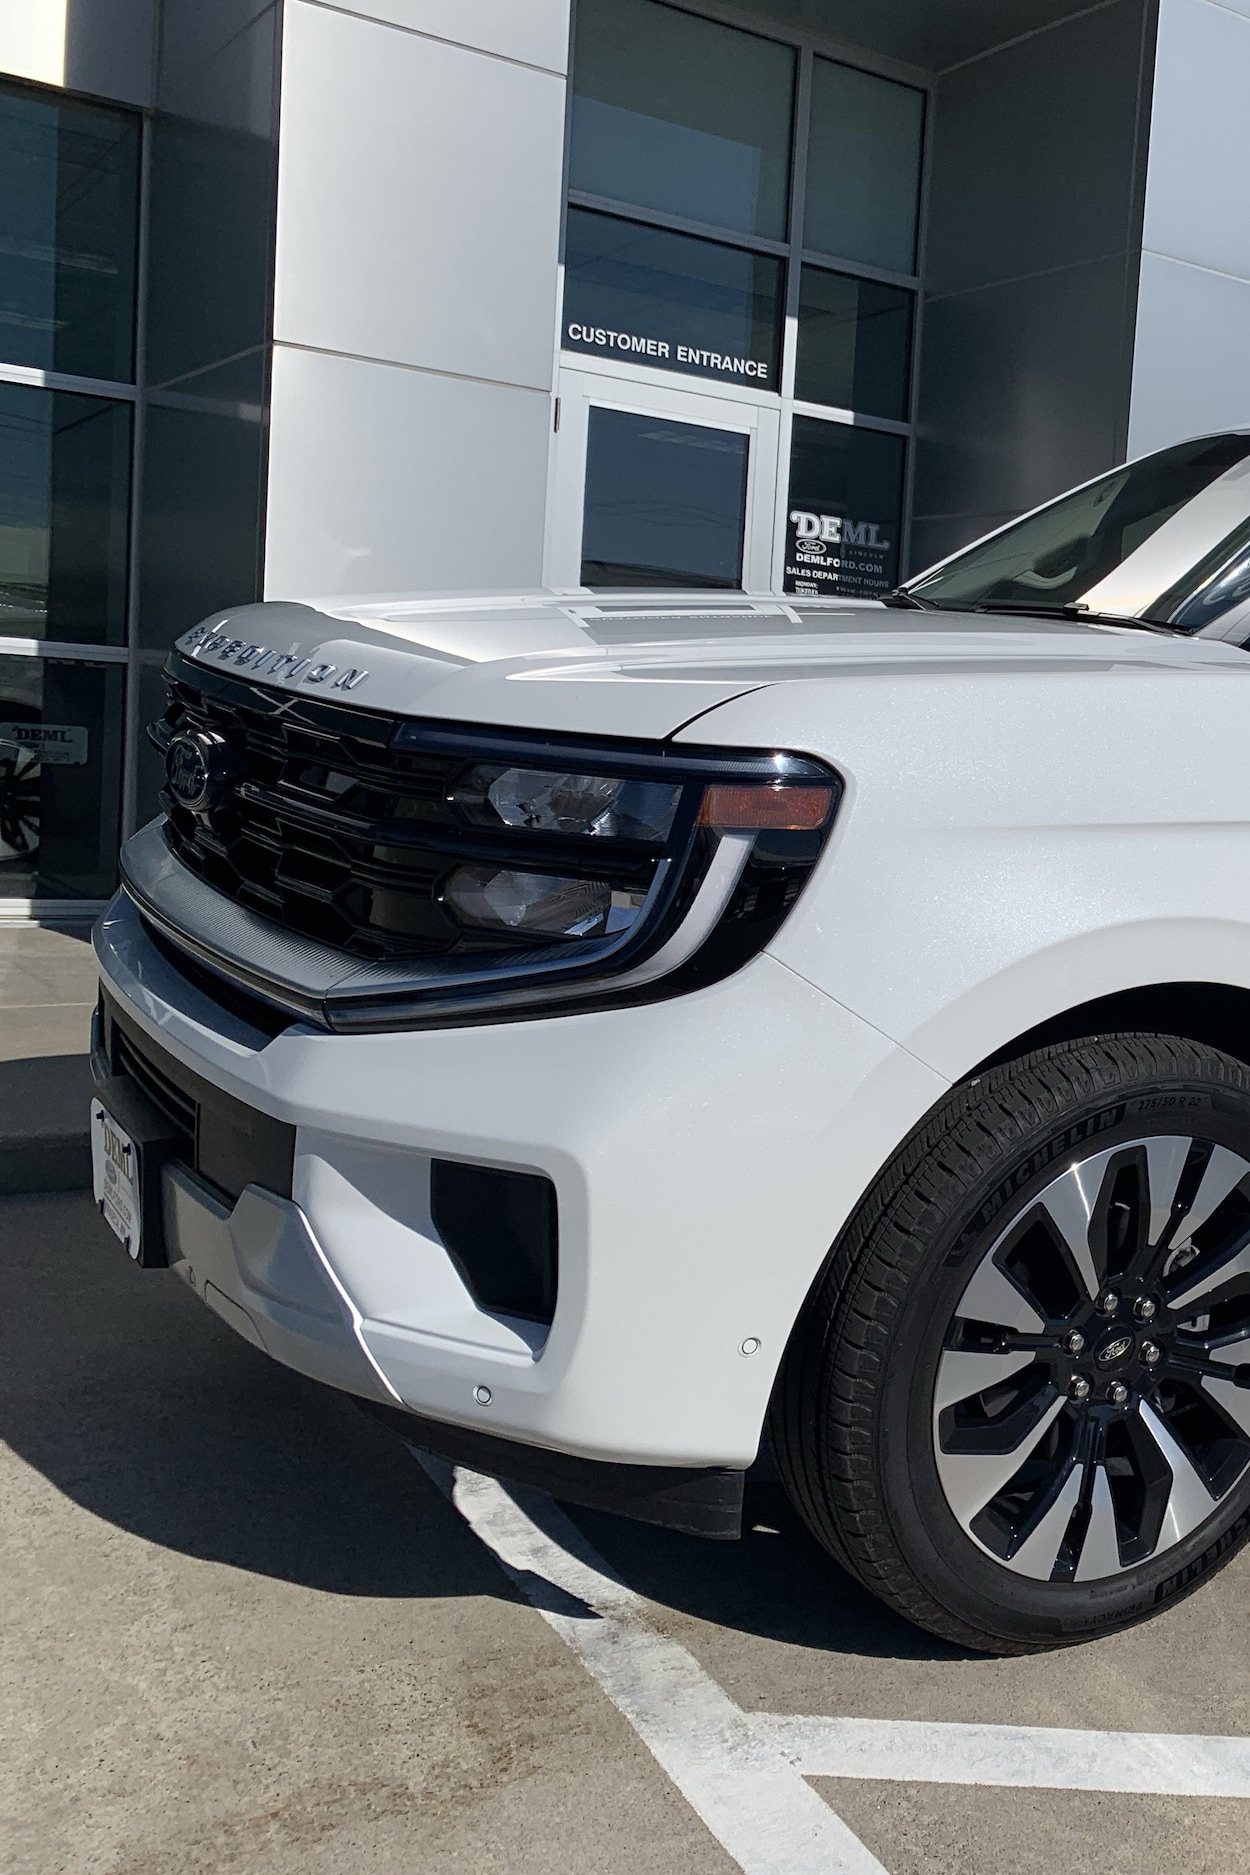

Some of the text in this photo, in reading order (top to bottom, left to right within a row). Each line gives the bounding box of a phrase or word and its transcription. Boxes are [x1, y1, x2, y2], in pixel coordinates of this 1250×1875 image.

[568, 323, 768, 379] CUSTOMER ENTRANCE
[789, 510, 890, 550] DEML
[801, 541, 885, 560] Ford LINCOLN
[796, 553, 883, 574] DEMLFORD.COM
[785, 566, 889, 589] SALES DEPARTMENT HOURS
[12, 726, 74, 744] DEML
[1137, 1096, 1202, 1111] 275/50 R 22
[982, 1108, 1118, 1225] MICHELIN
